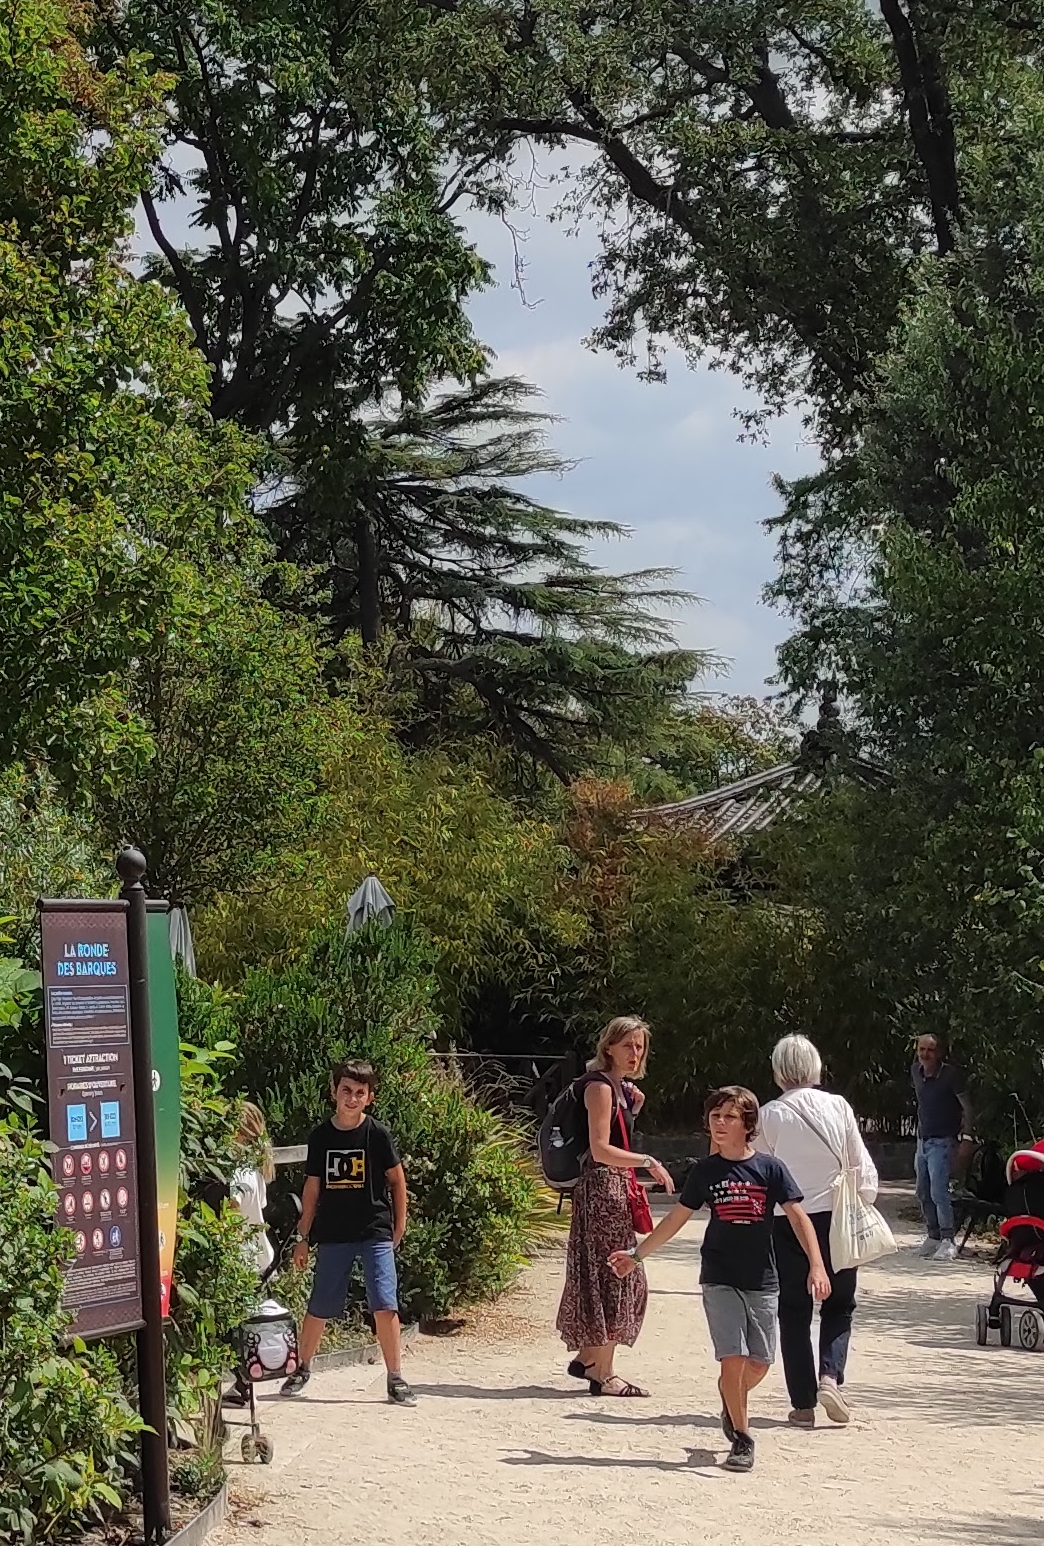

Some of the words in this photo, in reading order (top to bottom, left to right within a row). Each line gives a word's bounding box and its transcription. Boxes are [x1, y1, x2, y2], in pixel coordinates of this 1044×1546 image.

[64, 943, 76, 957] LA
[77, 943, 109, 957] RONDE
[57, 961, 75, 976] DES
[76, 961, 117, 977] BARQUES
[67, 1054, 85, 1064] TICKET
[86, 1053, 119, 1063] ATTRACTION
